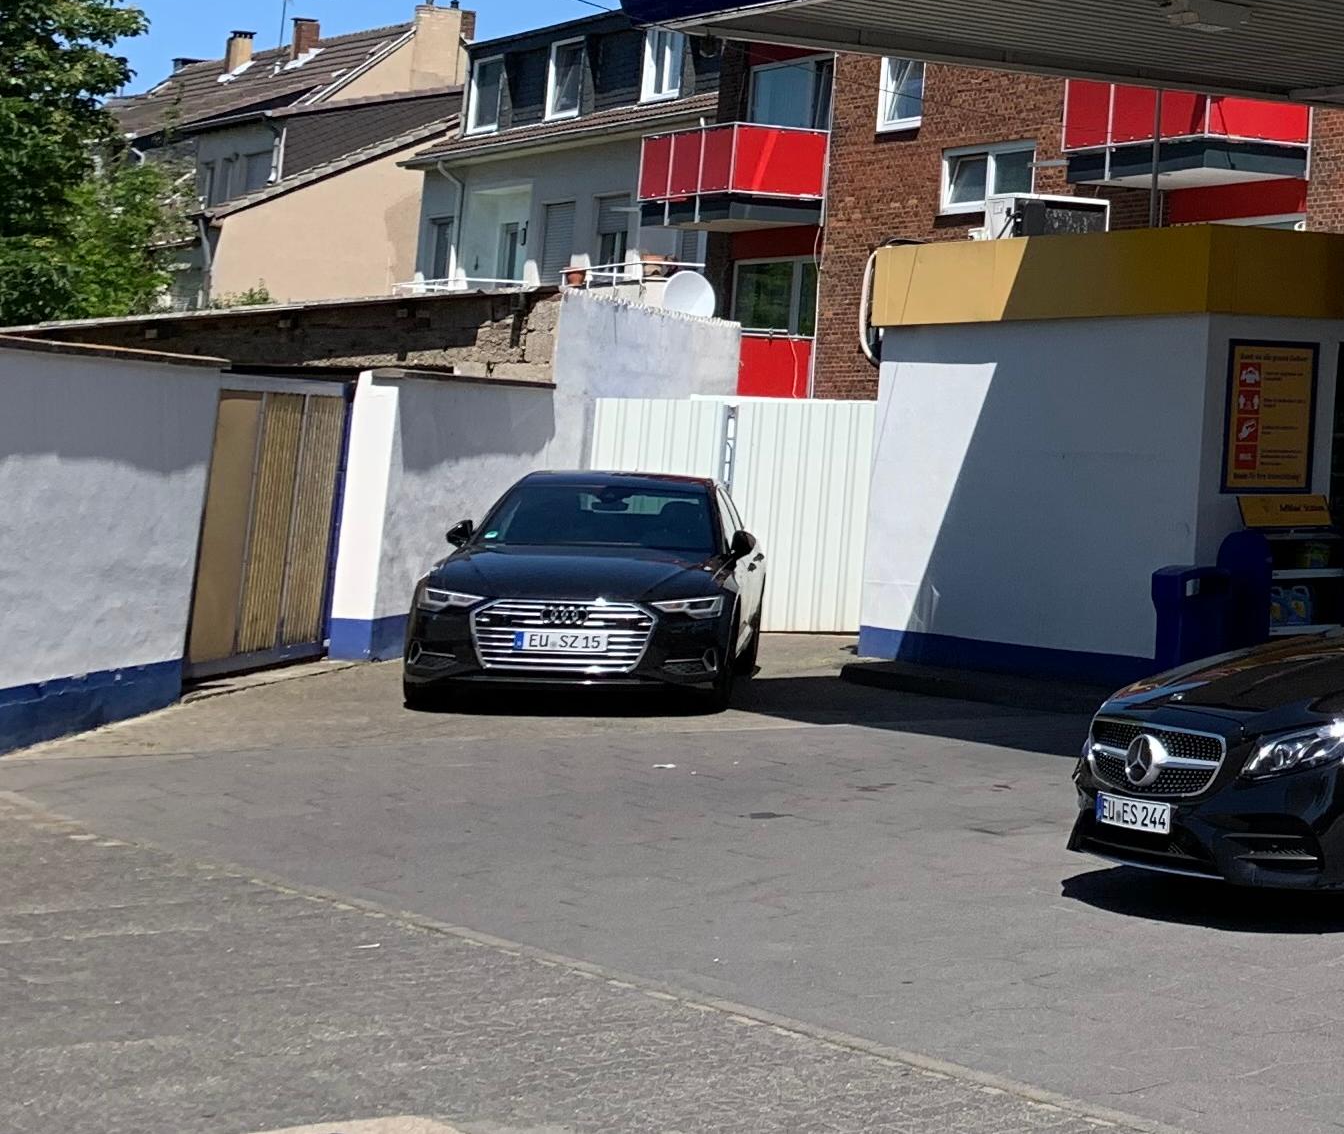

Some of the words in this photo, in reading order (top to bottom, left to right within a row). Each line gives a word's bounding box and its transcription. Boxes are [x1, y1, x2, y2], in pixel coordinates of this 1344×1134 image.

[529, 634, 549, 647] EU
[560, 635, 579, 648] SZ
[582, 636, 600, 648] 15
[1103, 798, 1115, 820] EU
[1123, 803, 1137, 824] ES
[1141, 806, 1166, 830] 244
